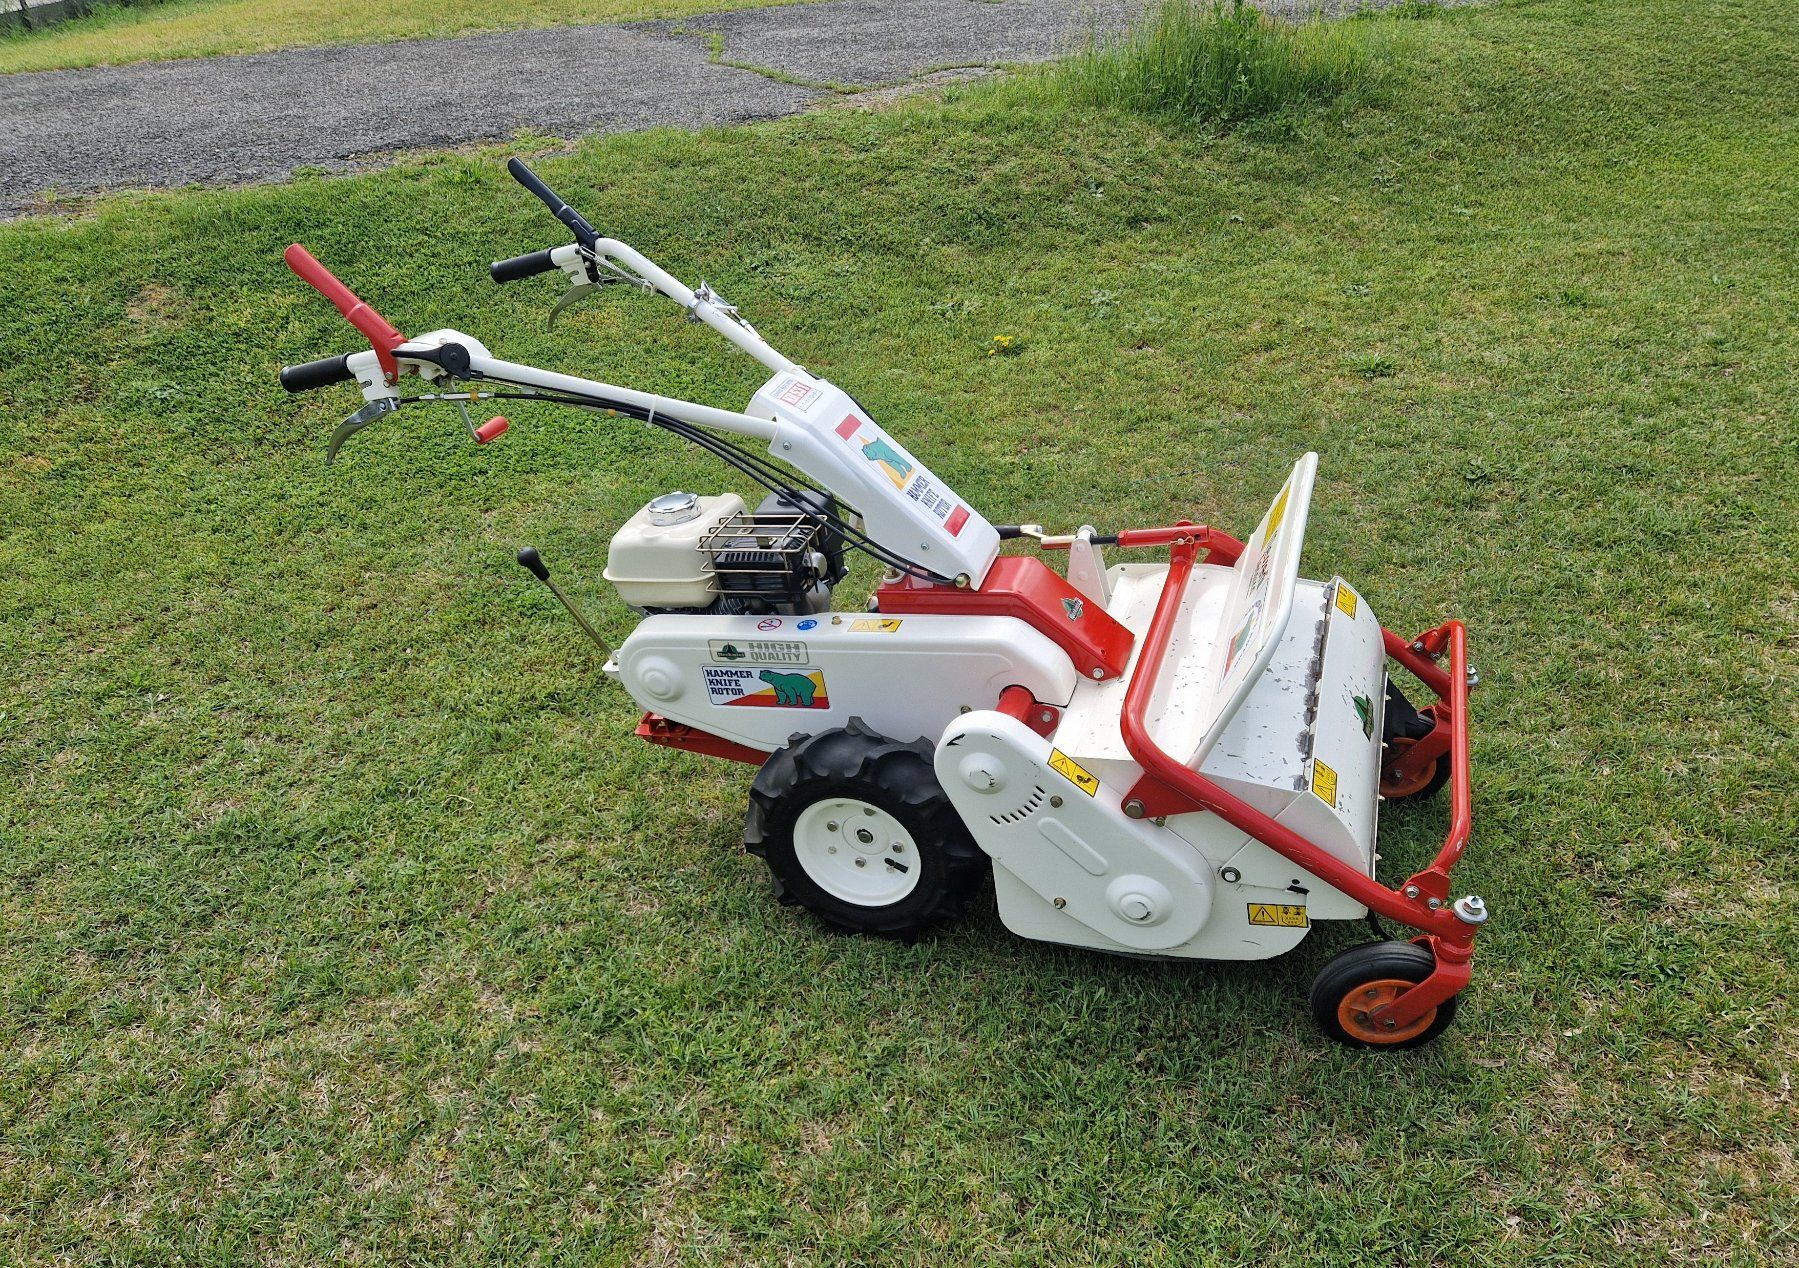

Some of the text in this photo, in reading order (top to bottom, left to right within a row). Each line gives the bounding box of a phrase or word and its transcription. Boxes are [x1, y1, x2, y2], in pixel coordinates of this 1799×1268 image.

[748, 642, 801, 652] HIGH
[750, 652, 801, 661] QUALITY
[705, 669, 754, 679] HAMMER
[708, 678, 741, 687] KNIFE
[711, 687, 745, 696] ROTOR
